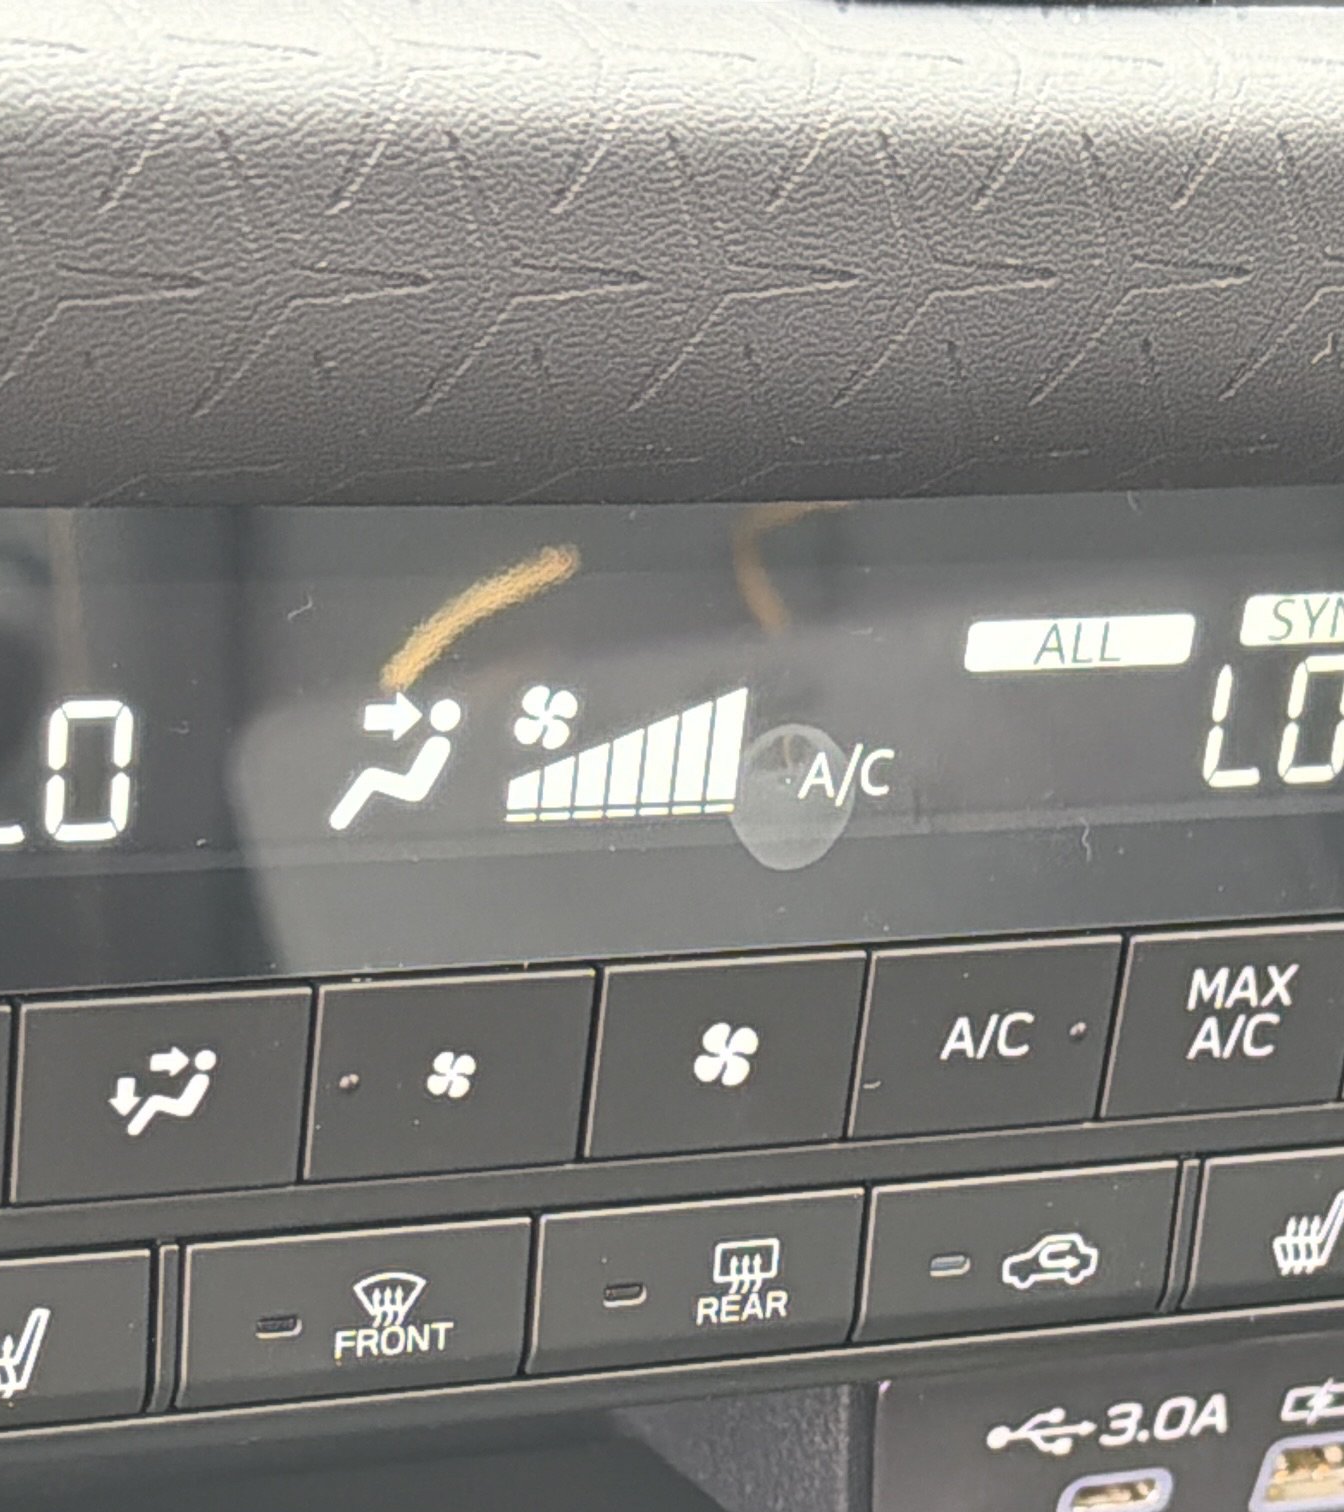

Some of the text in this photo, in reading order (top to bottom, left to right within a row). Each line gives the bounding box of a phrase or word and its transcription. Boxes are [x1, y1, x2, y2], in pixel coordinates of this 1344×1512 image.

[1034, 621, 1121, 665] ALL
[798, 743, 895, 807] A/C
[1187, 963, 1299, 1011] MAX
[939, 1011, 1034, 1060] A/C
[1185, 1011, 1281, 1060] A/C
[695, 1289, 788, 1326] REAR
[333, 1320, 455, 1361] FRONT
[1097, 1393, 1230, 1448] 3.0A
